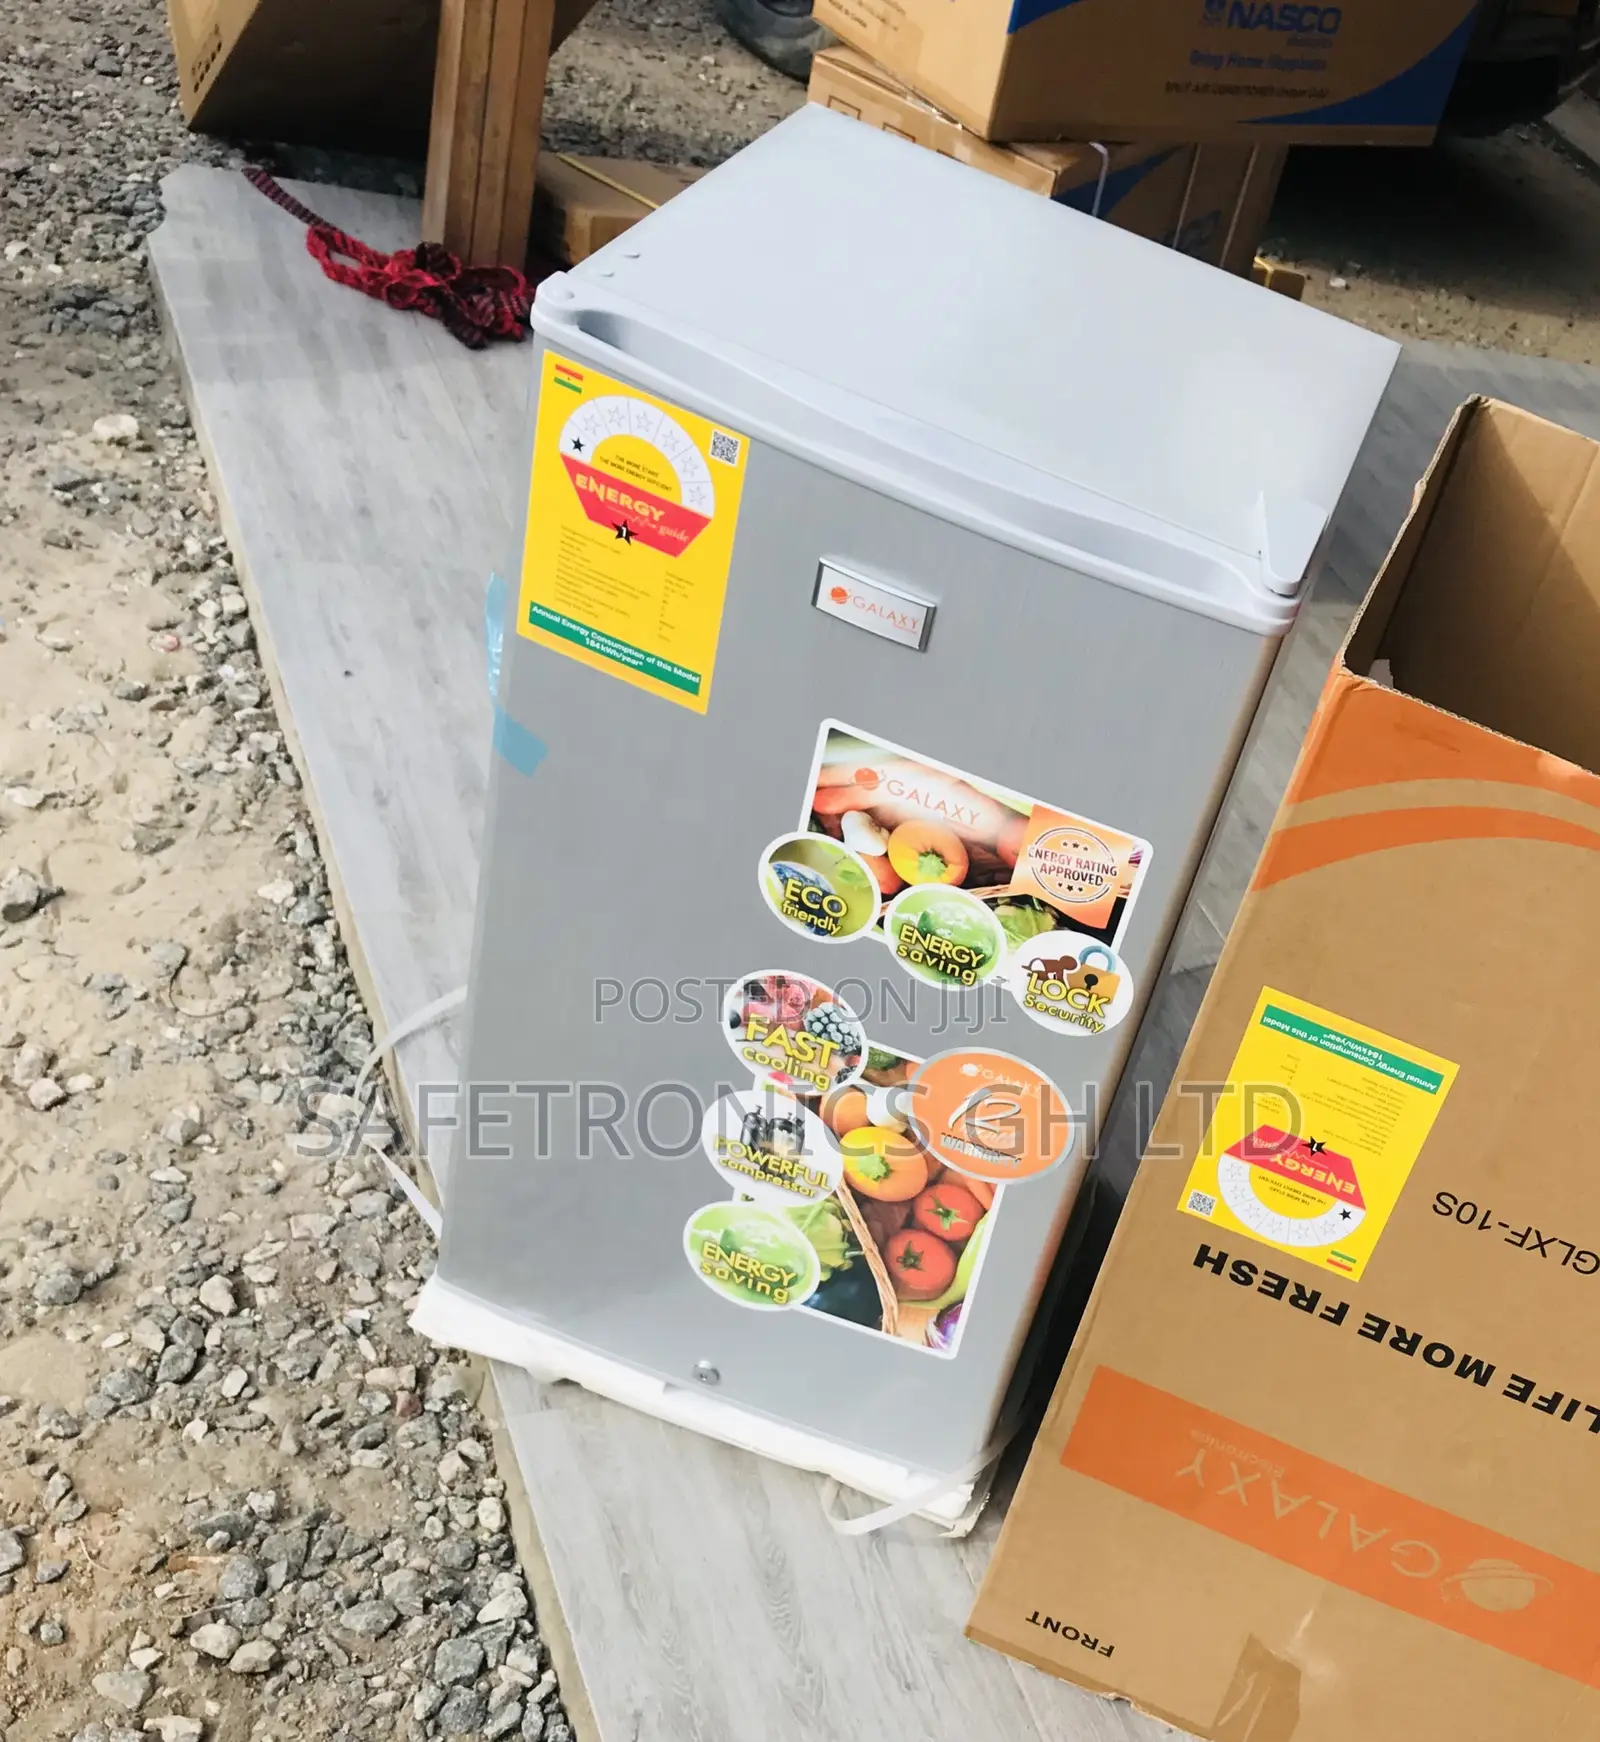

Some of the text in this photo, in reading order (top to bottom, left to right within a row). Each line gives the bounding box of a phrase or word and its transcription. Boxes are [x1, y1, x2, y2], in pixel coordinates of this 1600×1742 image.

[1227, 0, 1342, 34] NASCO
[621, 527, 627, 537] 1
[659, 525, 689, 542] guide
[852, 596, 920, 629] GALAXY
[531, 605, 700, 684] Annual Energy Consumption of this Model
[886, 779, 980, 825] GALAXY
[1028, 847, 1118, 878] ENERGY RATING
[1039, 864, 1104, 887] APPROVED
[782, 900, 843, 936] friendly
[785, 878, 848, 918] ECO
[897, 944, 977, 986] saving
[900, 924, 985, 968] ENERGY
[1023, 993, 1106, 1034] Security
[1027, 973, 1112, 1018] LOCK
[745, 1013, 840, 1069] FAST
[1263, 1016, 1437, 1091] Annual Energy Consumption of this Model
[1368, 1047, 1384, 1061] 184
[742, 1047, 831, 1092] cooling
[714, 1134, 831, 1191] POWERFUL
[1311, 1143, 1318, 1152] 1
[718, 1157, 817, 1199] compressor
[1432, 1192, 1600, 1275] GLXF-10S
[701, 1261, 789, 1304] saving
[702, 1241, 796, 1286] ENERGY
[1192, 1244, 1600, 1434] LIFE MORE FRESH
[1175, 1448, 1440, 1578] GALAXY
[1025, 1611, 1115, 1658] FRONT
